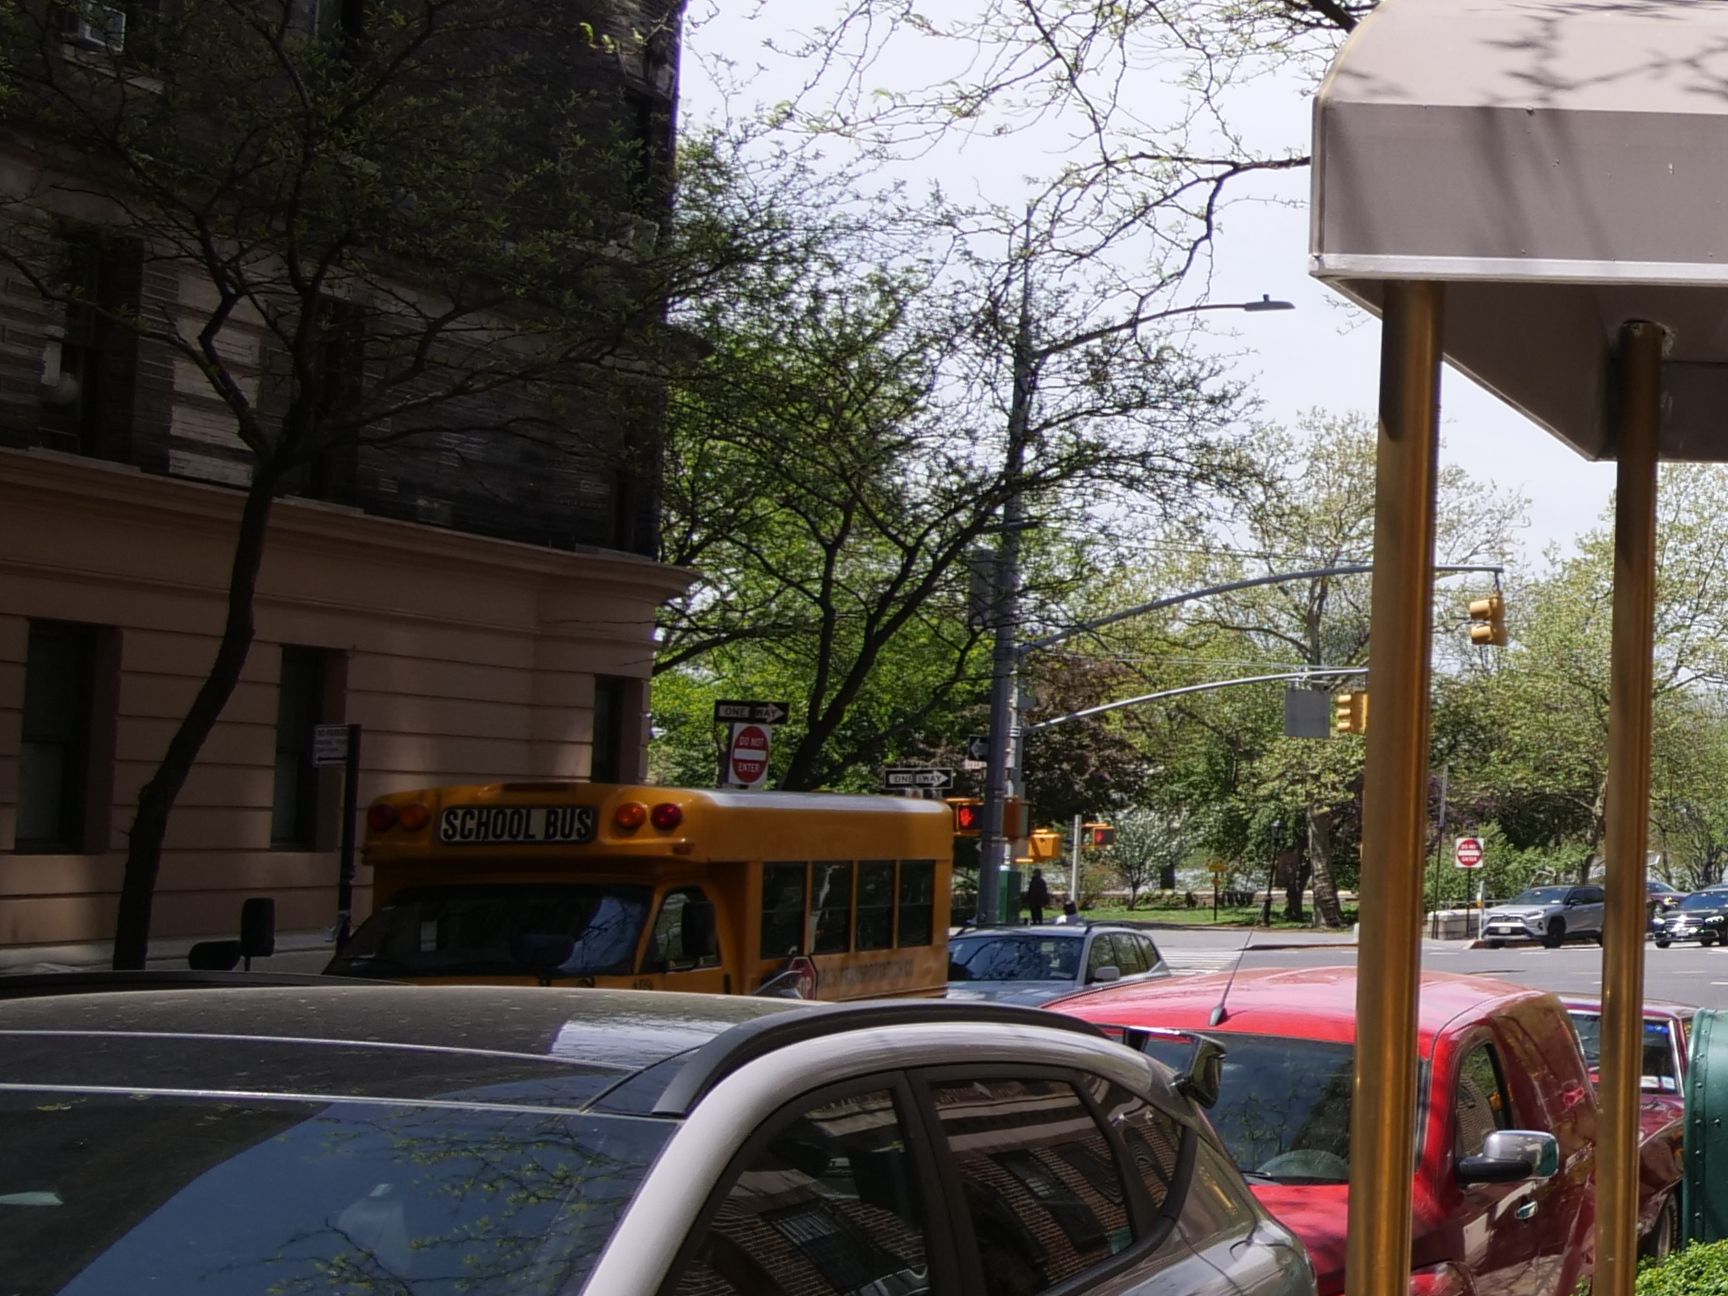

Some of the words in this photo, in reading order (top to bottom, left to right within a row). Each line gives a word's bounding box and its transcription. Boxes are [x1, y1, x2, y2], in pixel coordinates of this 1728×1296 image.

[725, 707, 746, 716] ONE
[756, 708, 778, 718] WAY
[740, 736, 750, 746] DO
[751, 737, 764, 747] NOT
[738, 762, 760, 772] ENTER
[922, 775, 941, 783] WAY
[443, 808, 536, 841] SCHOOL
[544, 808, 592, 840] BUS
